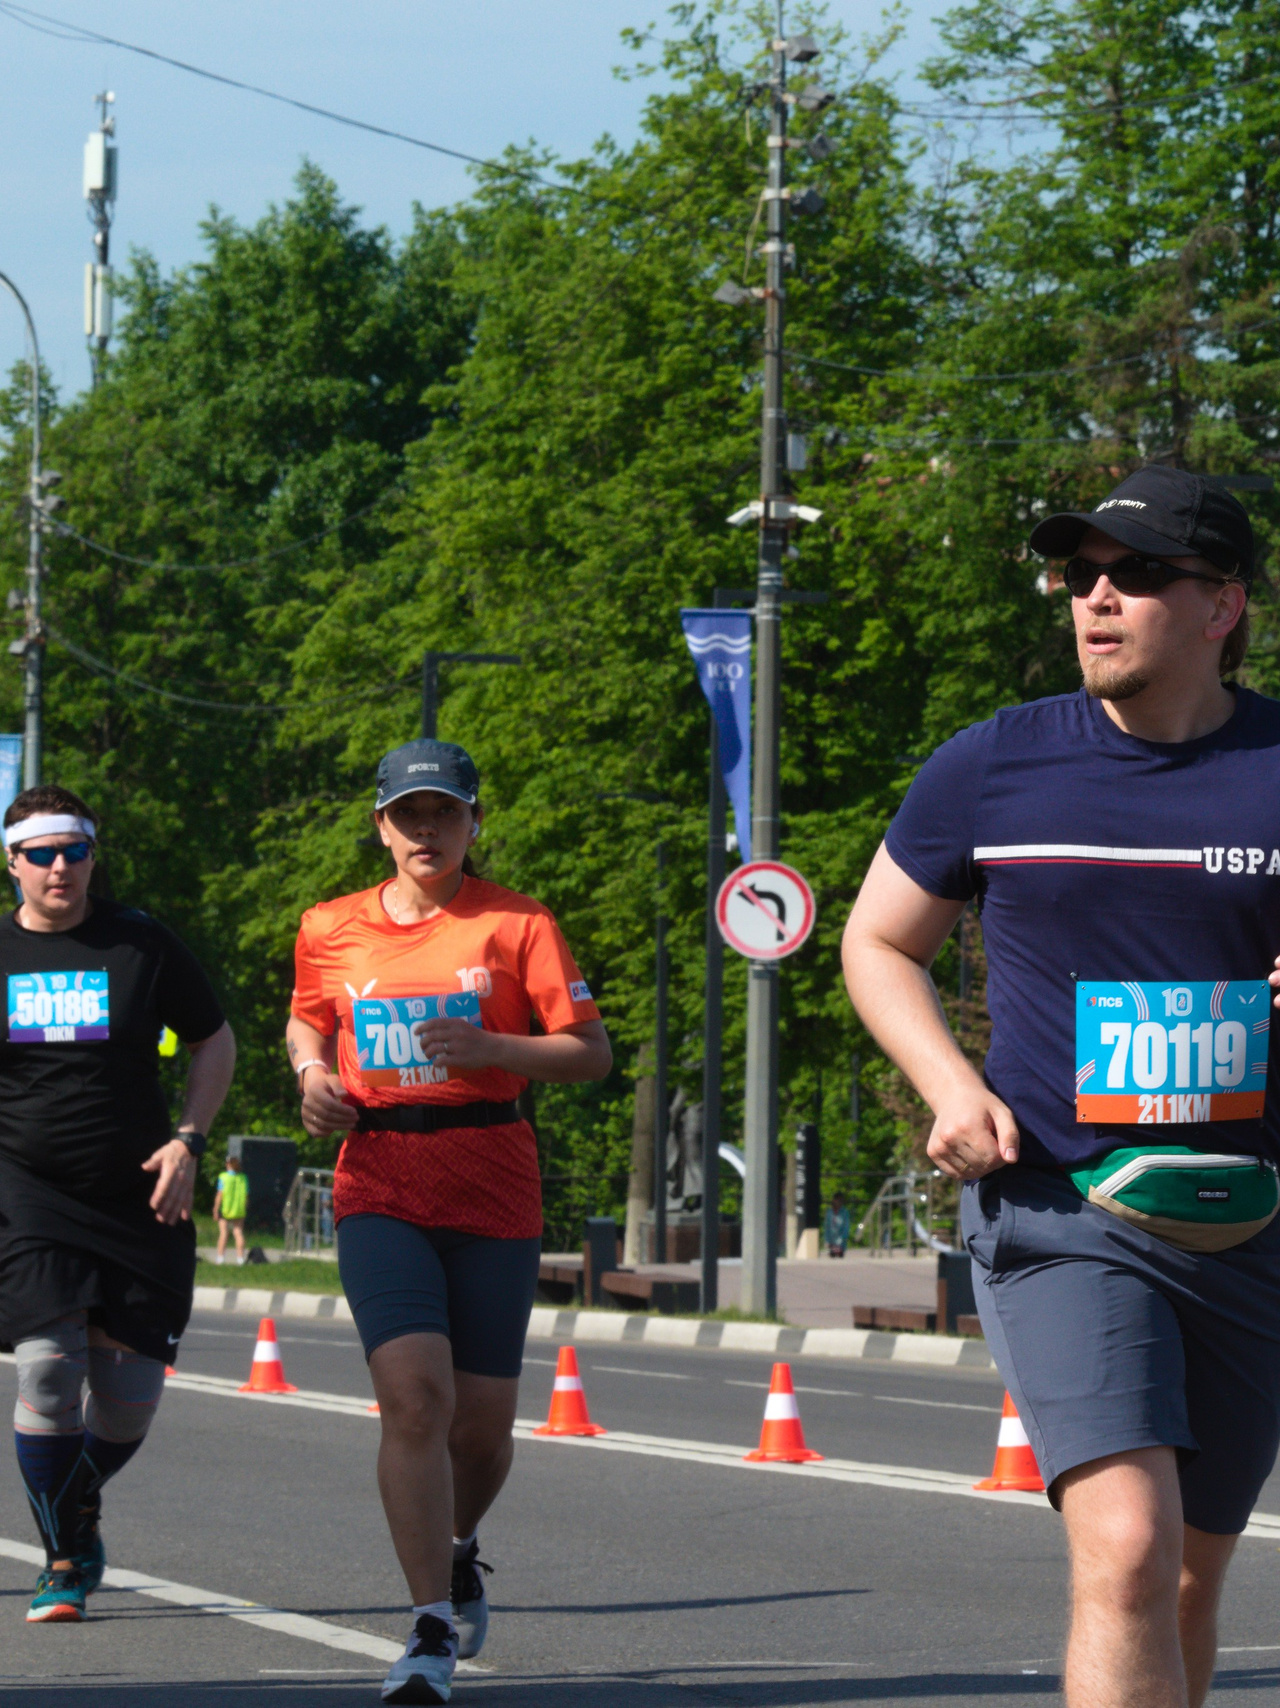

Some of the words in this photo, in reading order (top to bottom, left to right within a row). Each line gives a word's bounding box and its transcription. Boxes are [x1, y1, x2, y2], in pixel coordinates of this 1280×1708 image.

[707, 662, 744, 679] 100
[408, 763, 439, 773] SPORTS
[16, 989, 100, 1026] 50186
[366, 1008, 382, 1016] ПСБ
[405, 999, 427, 1019] 10
[1098, 997, 1124, 1008] ПСБ
[1161, 987, 1193, 1017] 10
[43, 1026, 76, 1042] 10KM
[1100, 1020, 1247, 1090] 70119
[398, 1065, 449, 1087] 21.1KM
[1137, 1093, 1212, 1124] 21.1KM
